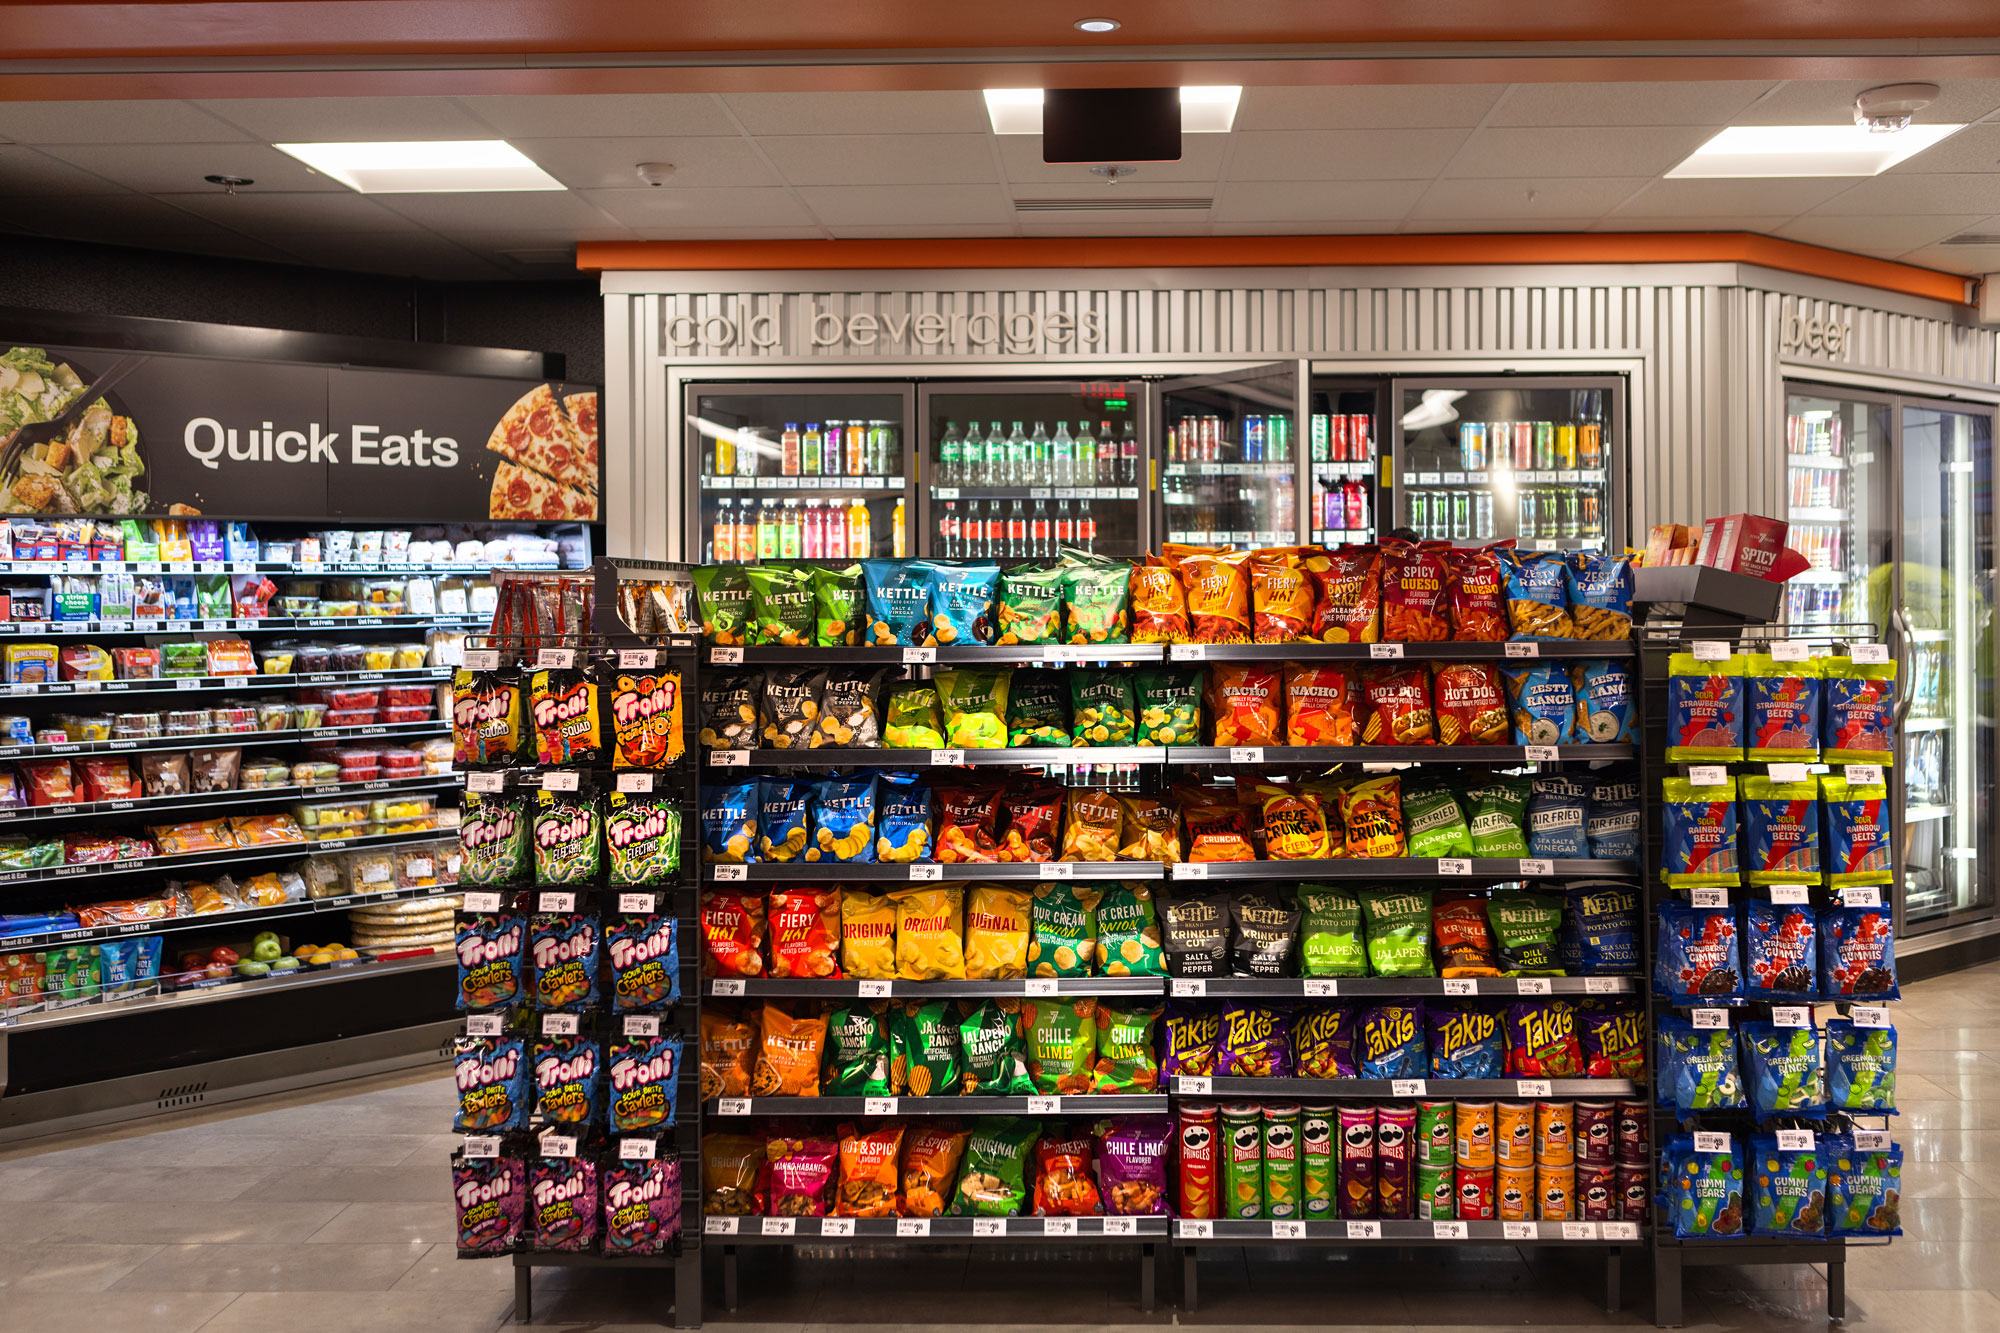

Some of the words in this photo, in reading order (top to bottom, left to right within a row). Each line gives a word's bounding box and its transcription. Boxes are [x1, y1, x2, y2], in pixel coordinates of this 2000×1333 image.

[665, 304, 782, 347] cold
[811, 301, 1100, 353] beverages
[1782, 304, 1851, 354] beer
[184, 418, 338, 469] Quick
[351, 425, 459, 468] Eats
[1741, 547, 1776, 566] SPICY
[1404, 567, 1434, 578] SPICY
[1524, 569, 1556, 579] ZESTY
[1585, 570, 1616, 583] ZESTY
[1268, 578, 1297, 589] FIERY
[1401, 578, 1438, 590] QUESO
[1463, 575, 1492, 585] SPICY
[1519, 578, 1563, 588] RANCH
[1577, 578, 1624, 591] RANCH
[878, 588, 927, 599] KETTLE
[939, 583, 987, 598] KETTLE
[1008, 584, 1056, 597] KETTLE
[1076, 586, 1124, 595] KETTLE
[1328, 584, 1362, 595] BAYOU
[1463, 584, 1498, 595] QUESO
[49, 684, 71, 692] Snacks
[767, 685, 812, 697] KETTLE
[1222, 687, 1268, 697] NACHO
[1290, 686, 1338, 697] NACHO
[1445, 687, 1470, 700] HOT
[1473, 686, 1495, 697] DOG
[1530, 684, 1568, 694] ZESTY
[1527, 694, 1573, 706] RANCH
[1694, 691, 1714, 699] SOUR
[1771, 692, 1790, 700] SOUR
[1679, 701, 1729, 709] STRAWBERRY
[1756, 702, 1805, 710] STRAWBERRY
[1837, 703, 1887, 712] STRAWBERRY
[1690, 708, 1717, 717] BELTS
[1767, 709, 1794, 718] BELTS
[1848, 711, 1875, 720] BELTS
[562, 721, 591, 738] SQUAD
[1266, 809, 1309, 823] CHEEZE
[1533, 814, 1549, 825] AIR
[1551, 810, 1580, 822] FRIED
[1589, 818, 1606, 829] AIR
[1608, 814, 1638, 827] FRIED
[1697, 817, 1716, 825] SOUR
[1265, 820, 1321, 842] CRUNCH
[1350, 821, 1404, 843] CRUNCH
[1688, 825, 1726, 834] RAINBOW
[1767, 824, 1806, 833] RAINBOW
[1846, 825, 1881, 833] RAINBOW
[1414, 831, 1463, 850] JALAPEÑO
[1693, 834, 1720, 843] BELTS
[1772, 832, 1800, 841] BELTS
[627, 839, 658, 861] ELECTRIC
[1285, 841, 1312, 853] FIERY
[1369, 843, 1396, 856] FIERY
[1534, 844, 1577, 853] VINEGAR
[1111, 904, 1144, 918] CREAM
[780, 913, 815, 927] FIERY
[1053, 912, 1086, 926] CREAM
[1309, 919, 1339, 927] POTATO
[1039, 921, 1081, 938] ONION
[1100, 918, 1139, 933] ONION
[82, 930, 93, 938] Eat
[781, 927, 810, 942] HOT
[1171, 929, 1220, 939] KRINKLE
[1243, 931, 1289, 941] KRINKLE
[1503, 926, 1553, 937] KRINKLE
[1186, 939, 1206, 947] CUT
[1519, 934, 1539, 942] CUT
[458, 926, 520, 966] Trolli
[610, 925, 671, 969] Trolli
[1307, 944, 1363, 956] JALAPEÑO
[1465, 953, 1484, 961] LIME
[1524, 949, 1542, 957] DILL
[1766, 948, 1803, 959] GUMMIS
[1842, 952, 1882, 962] GUMMIS
[1183, 964, 1213, 974] PEPPER
[1251, 965, 1280, 974] PEPPER
[463, 969, 511, 992] Crawlers
[539, 969, 584, 994] Crawlers
[617, 970, 663, 995] Crawlers
[1038, 1028, 1071, 1044] CHILE
[1112, 1027, 1144, 1044] CHILE
[1438, 1013, 1495, 1058] Takis
[1519, 1008, 1573, 1056] Takis
[841, 1037, 867, 1048] RANCH
[1038, 1046, 1073, 1060] LIME
[1768, 1056, 1793, 1066] GREEN
[1794, 1055, 1817, 1063] APPLE
[1842, 1055, 1867, 1063] GREEN
[1868, 1055, 1892, 1064] APPLE
[456, 1050, 518, 1090] Trolli
[536, 1050, 592, 1087] Trolli
[611, 1050, 672, 1089] Trolli
[1779, 1063, 1808, 1074] RINGS
[1851, 1063, 1882, 1072] RINGS
[615, 1093, 663, 1116] Crawlers
[970, 1137, 1017, 1160] ORIGINAL
[1183, 1148, 1210, 1160] PRINGLES
[1266, 1148, 1294, 1160] PRINGLES
[1346, 1146, 1373, 1158] PRINGLES
[1379, 1145, 1404, 1159] PRINGLES
[1126, 1156, 1151, 1164] FLAVORED
[1234, 1148, 1260, 1161] PRINGLES
[1696, 1179, 1726, 1189] GUMMI
[1775, 1177, 1808, 1188] GUMMI
[1847, 1176, 1882, 1187] GUMMI
[1697, 1189, 1726, 1198] BEARS
[1776, 1187, 1808, 1197] BEARS
[1849, 1186, 1882, 1195] BEARS
